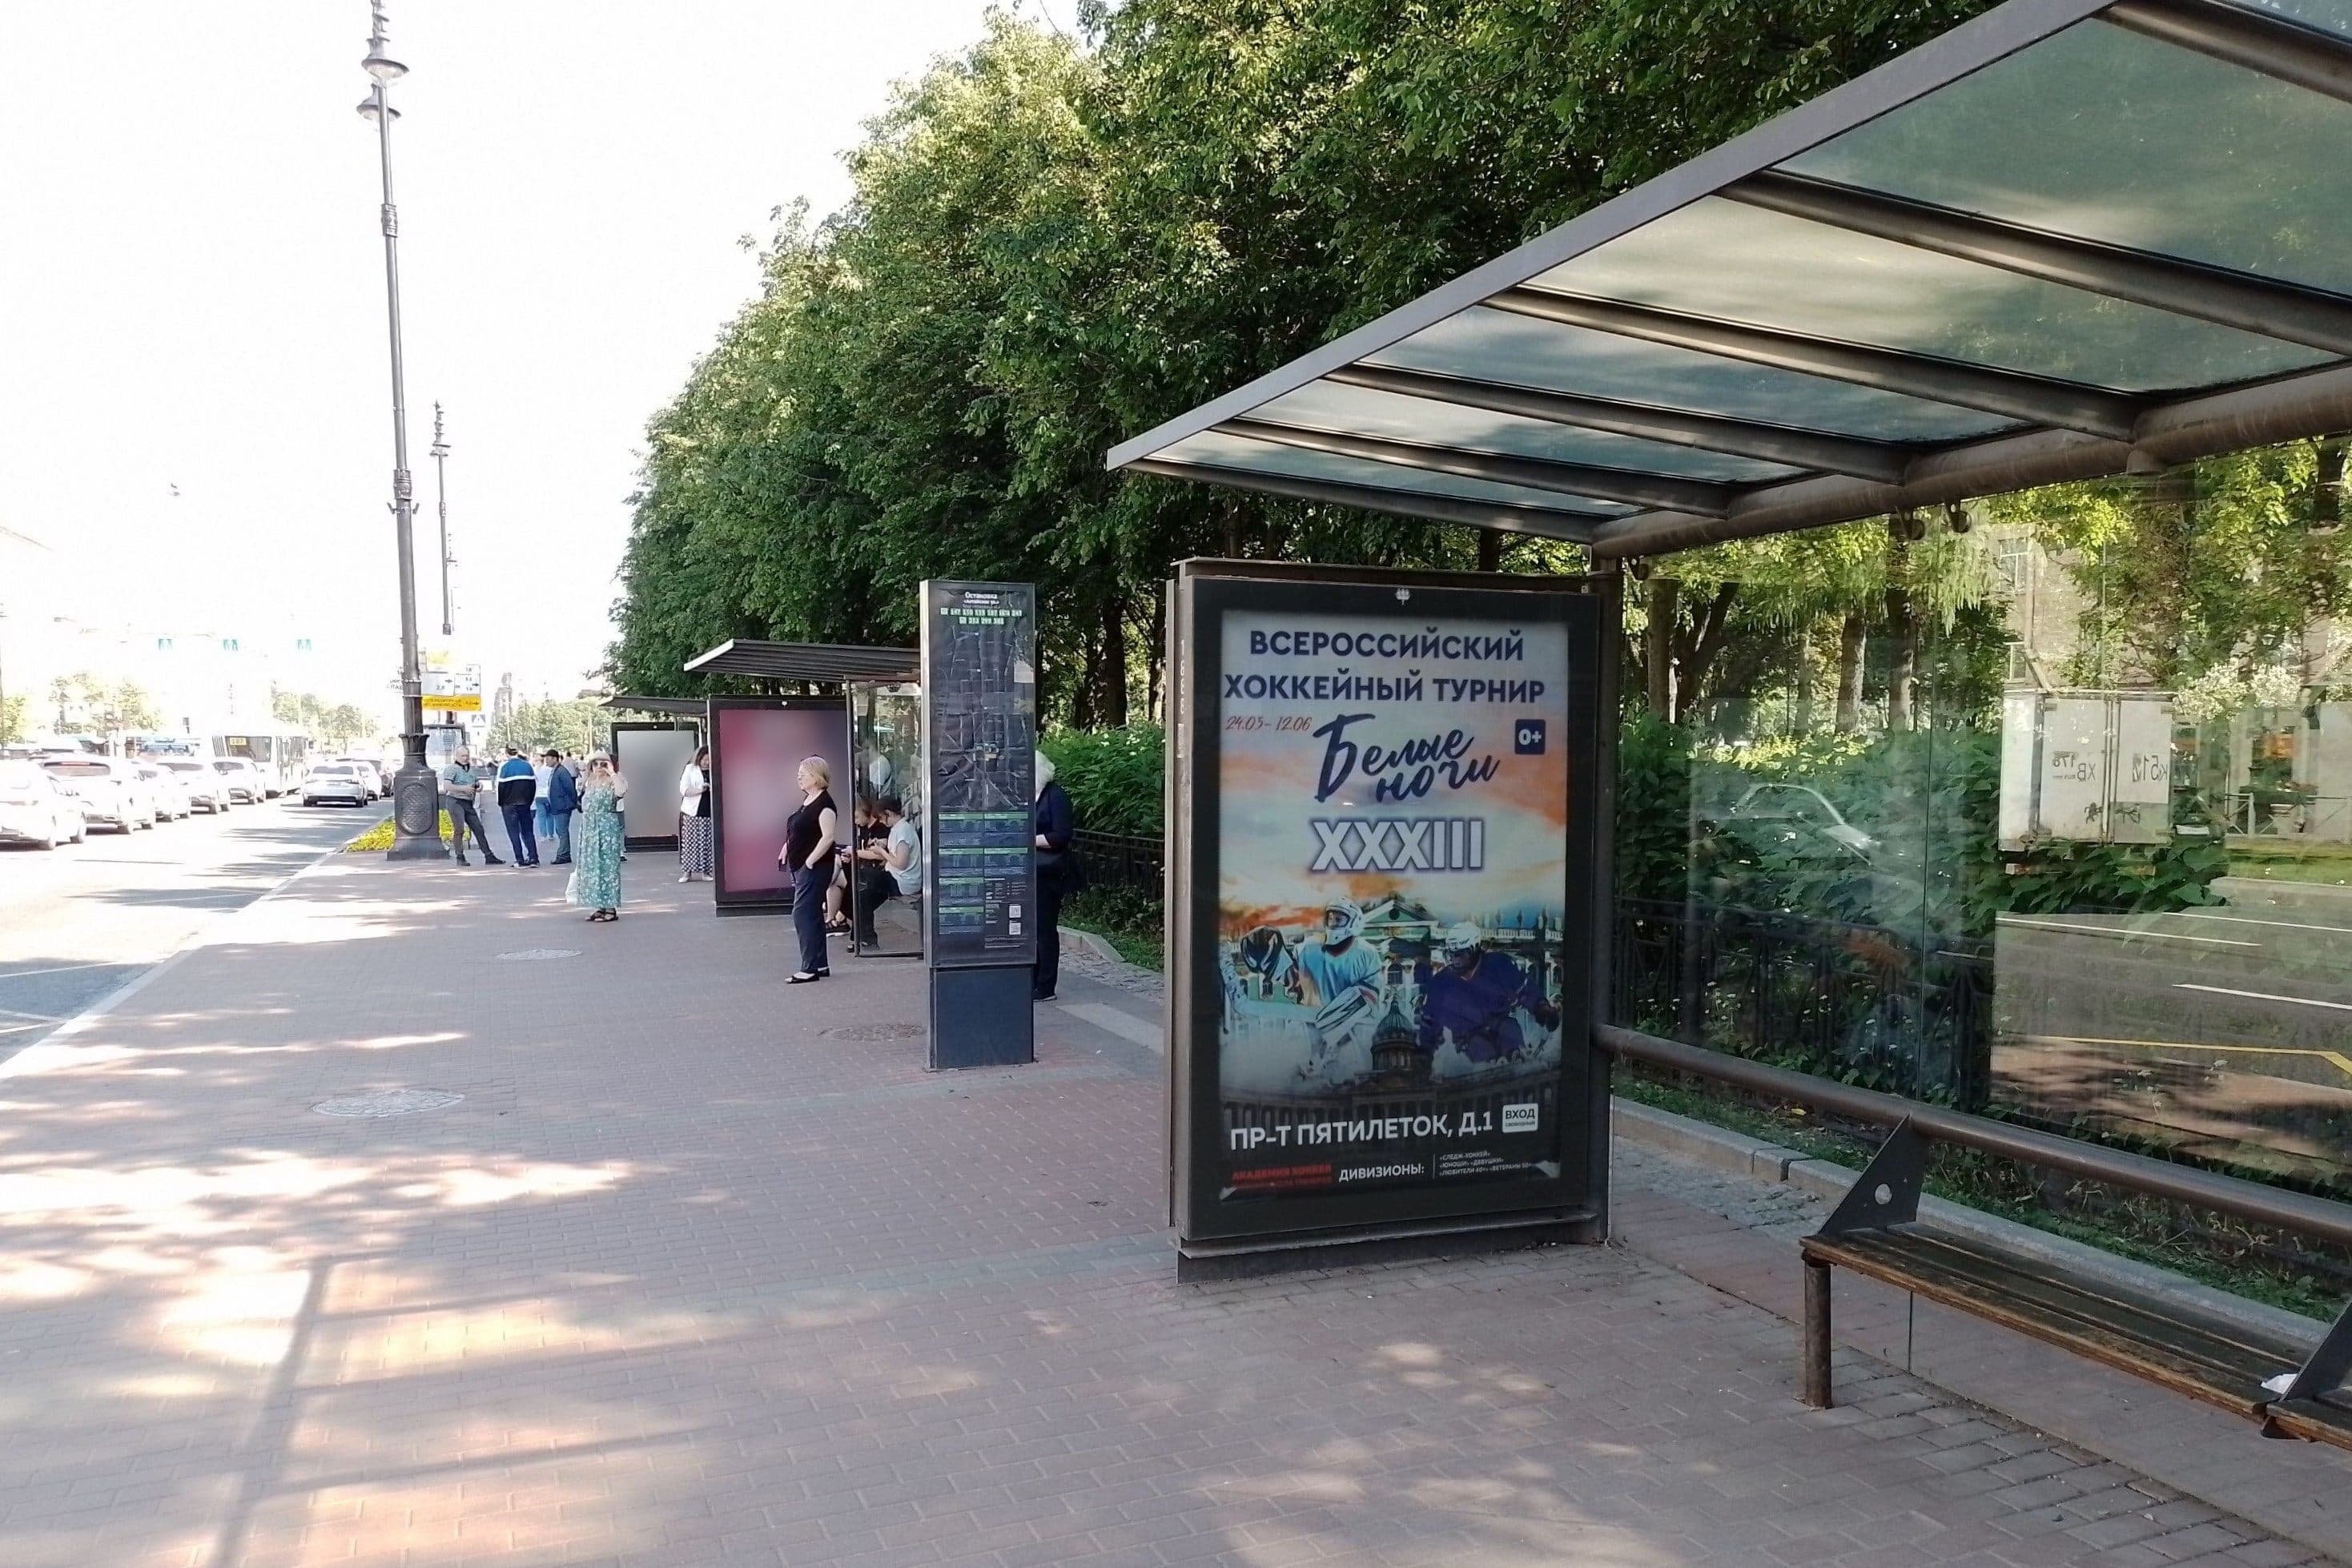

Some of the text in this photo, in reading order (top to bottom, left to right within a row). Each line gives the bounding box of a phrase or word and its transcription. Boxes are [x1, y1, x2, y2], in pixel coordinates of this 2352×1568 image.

[1249, 626, 1524, 661] ВСЕРОССИЙСКИЙ
[1224, 667, 1546, 703] ХОККЕЙНЫЙ ТУРНИР
[1518, 728, 1542, 746] 0+
[1312, 713, 1475, 803] Белые
[1375, 754, 1502, 803] ночи
[1310, 818, 1486, 872] XXXIII
[1230, 1111, 1494, 1151] ПР-Т ПЯТИЛЕТОК, Д.1
[1505, 1108, 1535, 1120] ВХОД
[1338, 1163, 1425, 1183] ДИВИЗИОНЫ:
